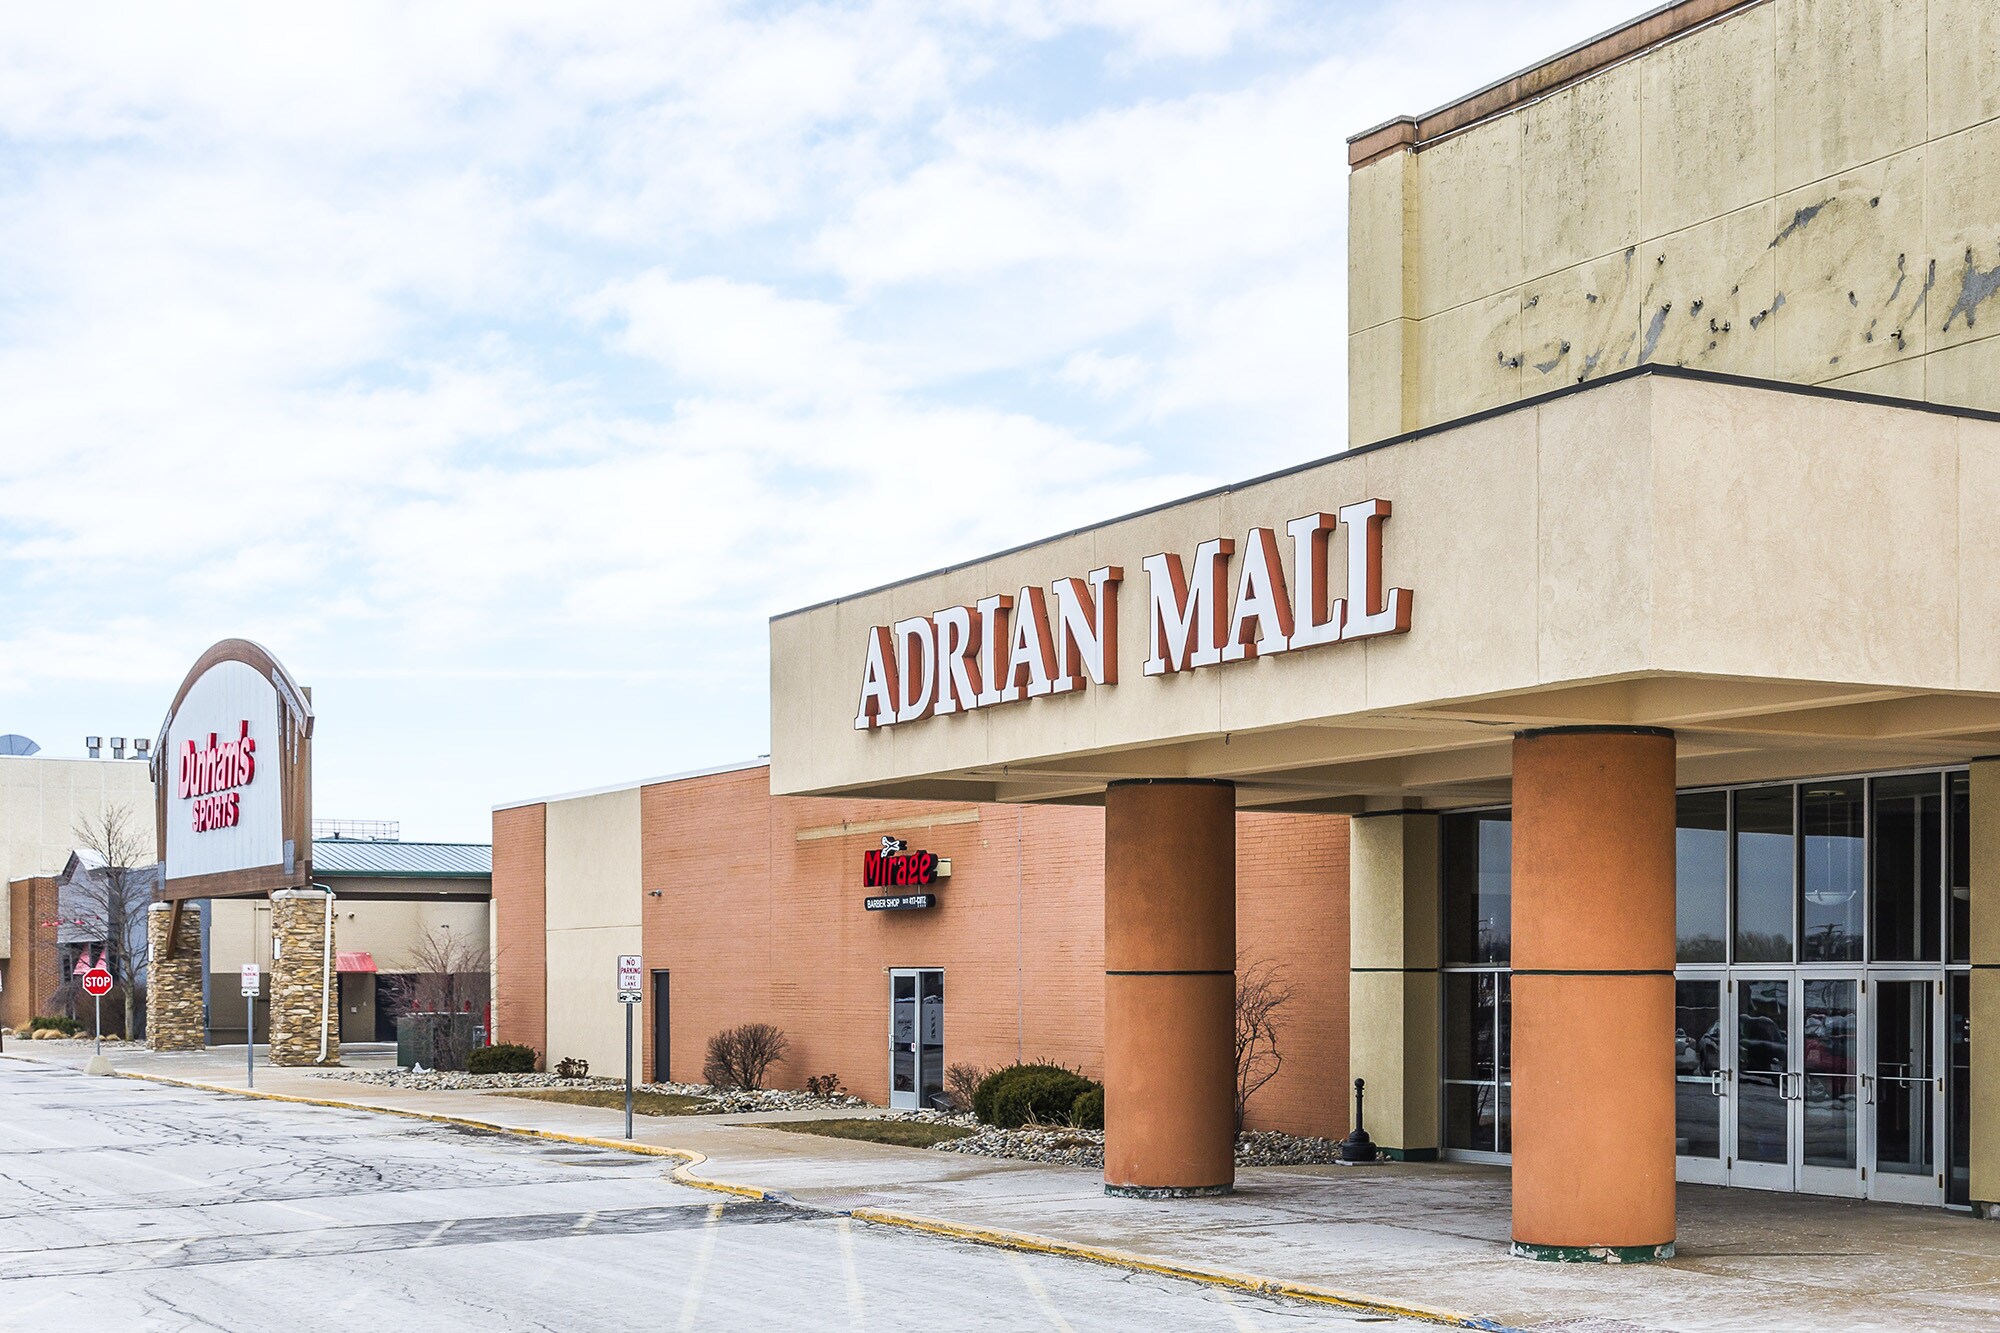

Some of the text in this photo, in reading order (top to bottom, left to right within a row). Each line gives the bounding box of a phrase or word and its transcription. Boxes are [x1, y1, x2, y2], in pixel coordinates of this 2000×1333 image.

[854, 498, 1414, 731] ADRIAN MALL
[178, 720, 255, 800] Dunham's
[192, 792, 240, 833] SPORTS
[863, 849, 934, 887] Mirage
[867, 899, 887, 909] BARBER
[887, 898, 900, 908] SHOP
[85, 976, 111, 987] STOP
